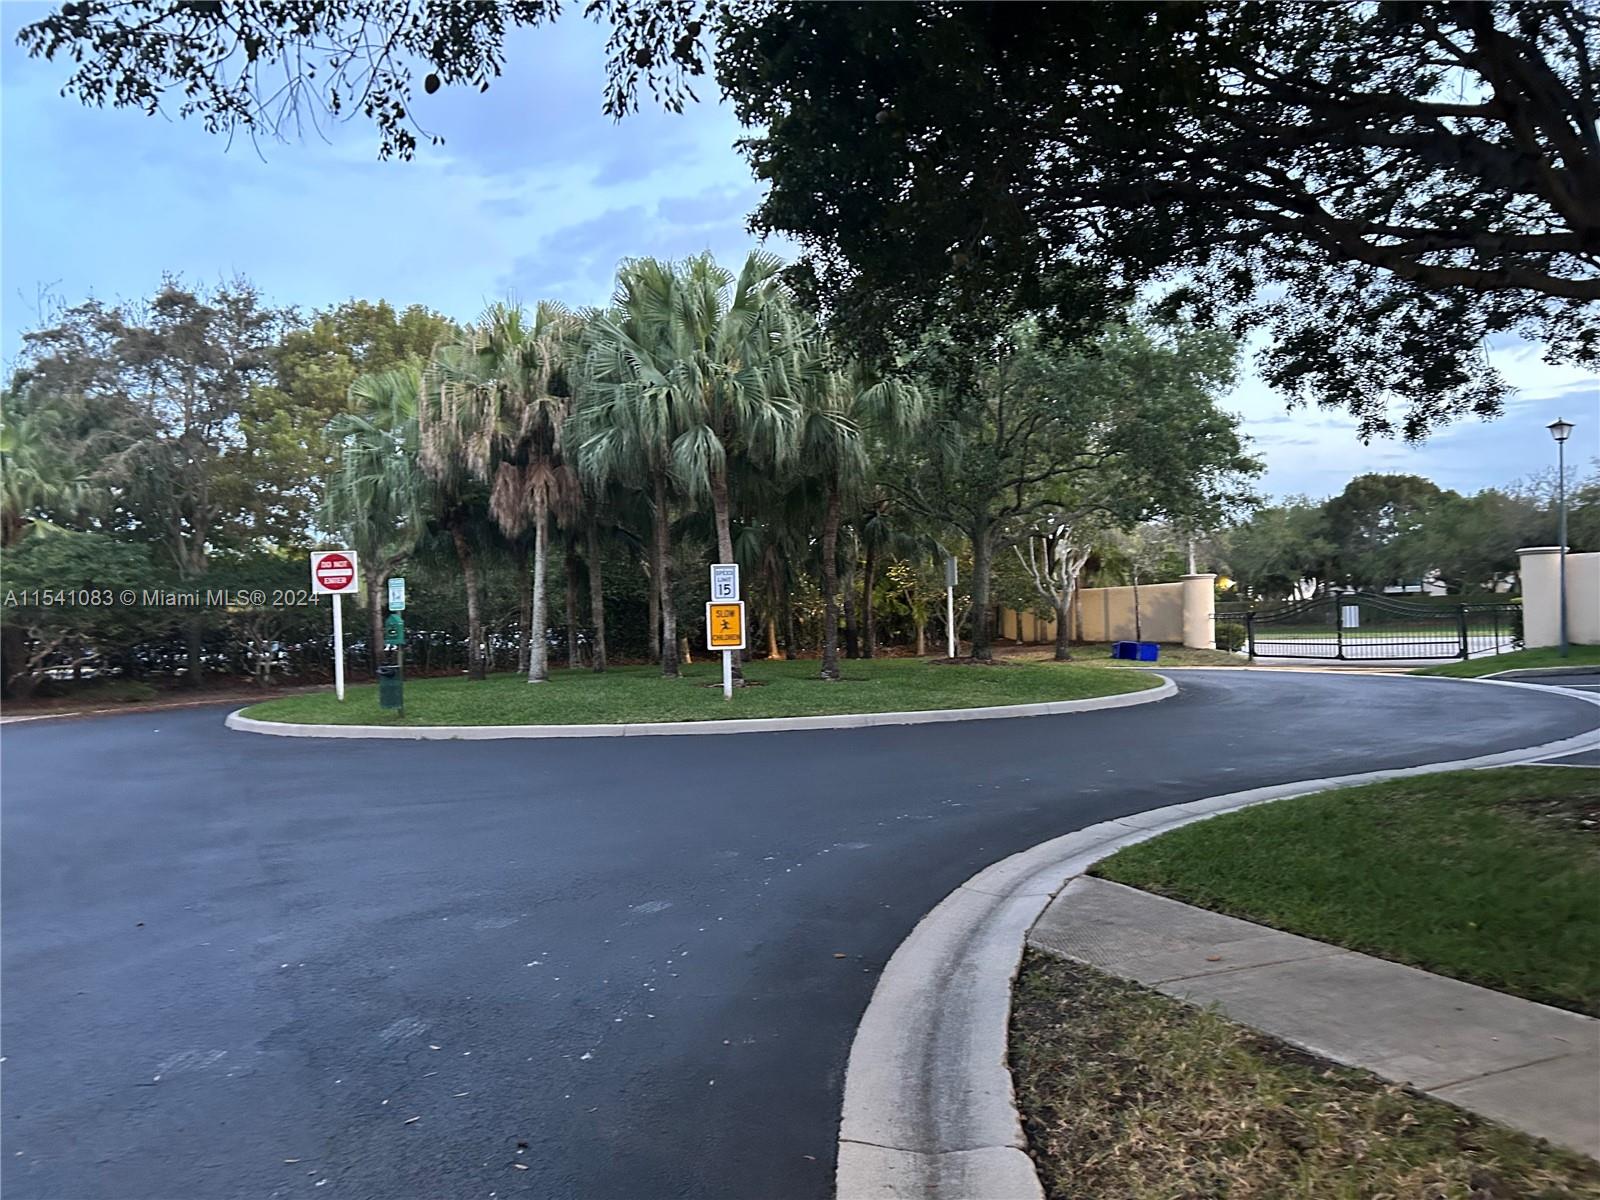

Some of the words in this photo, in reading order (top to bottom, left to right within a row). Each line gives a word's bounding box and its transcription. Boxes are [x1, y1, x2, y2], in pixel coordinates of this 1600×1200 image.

[333, 560, 348, 568] NOT
[718, 584, 731, 596] 15
[716, 610, 735, 618] SLOW
